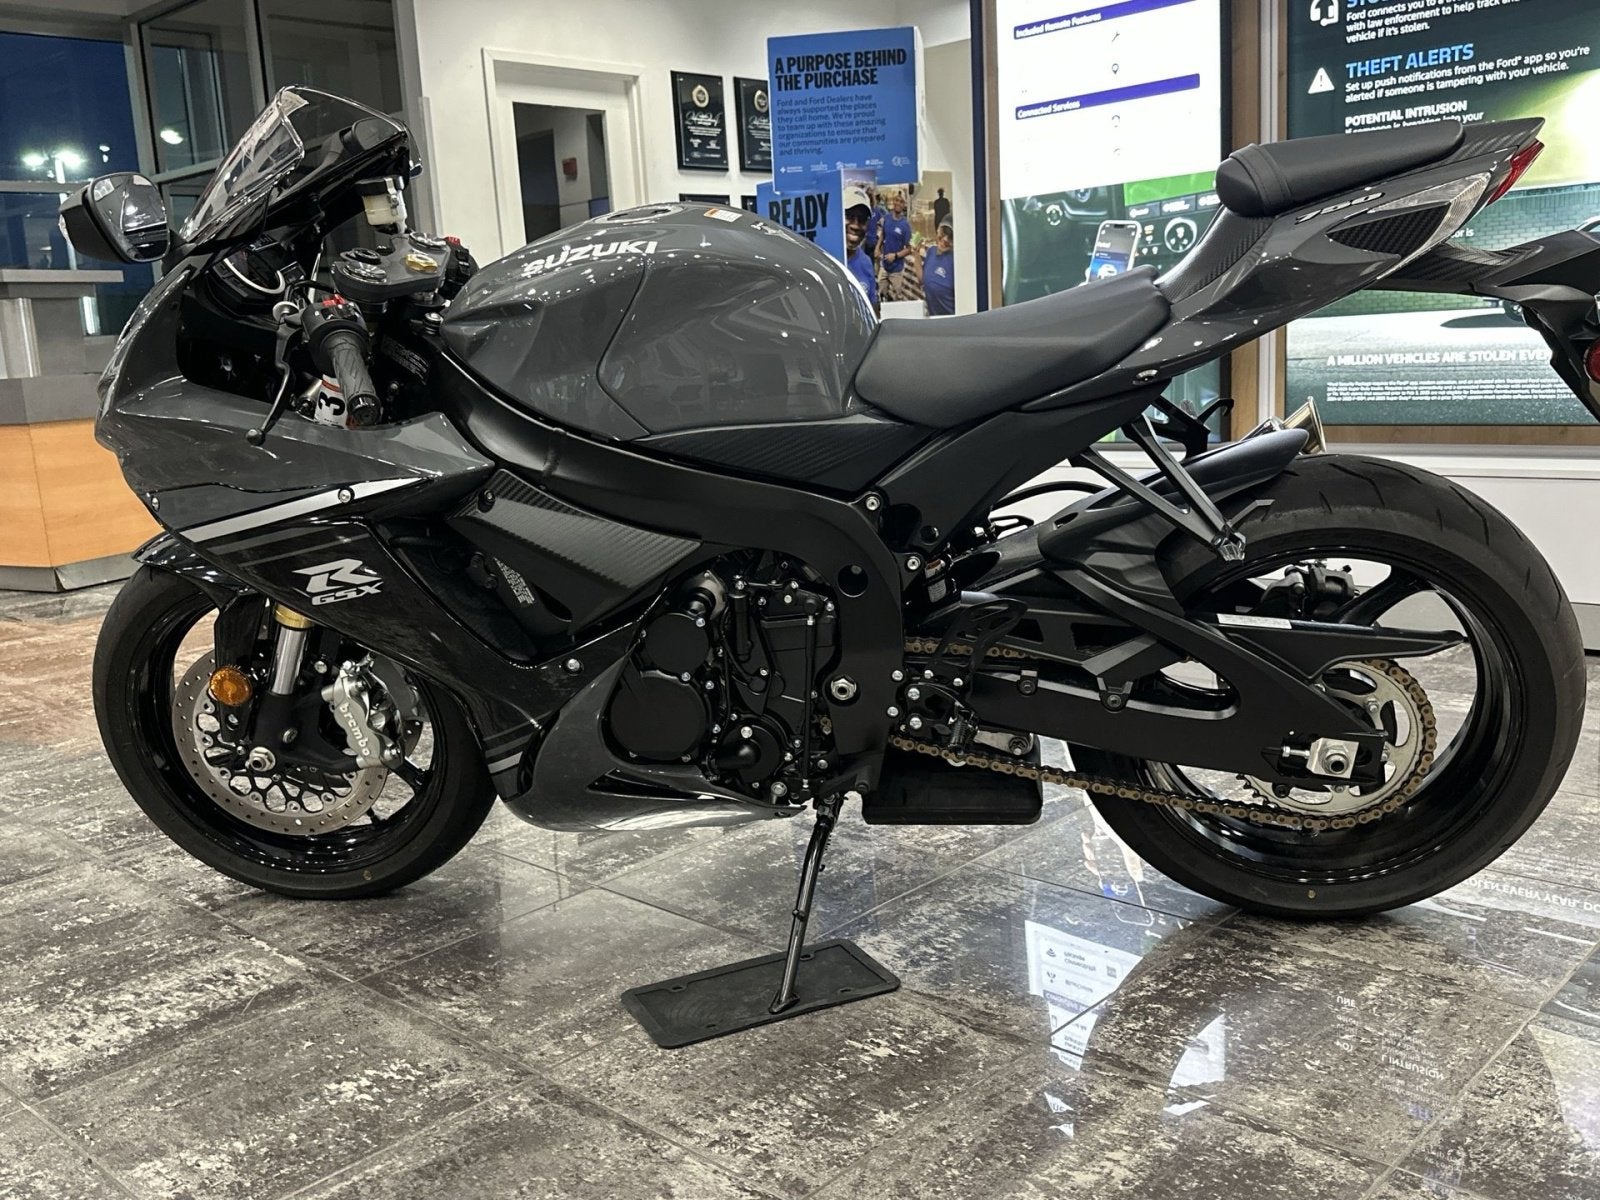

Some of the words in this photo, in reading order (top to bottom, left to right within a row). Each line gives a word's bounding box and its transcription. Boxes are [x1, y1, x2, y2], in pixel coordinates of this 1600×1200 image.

[1346, 10, 1366, 21] Ford
[1367, 4, 1406, 17] connects
[1407, 0, 1424, 11] you
[1346, 21, 1366, 32] with
[1366, 19, 1383, 28] law
[1384, 8, 1440, 25] enforcement
[1442, 7, 1452, 15] to
[1454, 2, 1475, 13] help
[1346, 30, 1376, 43] vehicle
[1400, 22, 1430, 34] stolen.
[775, 58, 784, 74] A
[786, 52, 852, 73] PURPOSE
[854, 48, 907, 69] BEHIND
[1346, 54, 1402, 78] THEFT
[1405, 43, 1474, 69] ALERTS
[1346, 82, 1360, 92] Set
[1361, 81, 1373, 90] up
[1375, 76, 1397, 88] push
[1398, 68, 1452, 83] notifications
[1454, 64, 1476, 75] from
[1478, 61, 1495, 72] the
[1524, 54, 1543, 65] app
[1545, 52, 1557, 61] so
[1559, 46, 1590, 60] you're
[775, 74, 802, 91] THE
[804, 68, 878, 89] PURCHASE
[1345, 90, 1375, 103] alerted
[1384, 83, 1425, 97] someone
[1426, 82, 1434, 91] is
[1436, 74, 1484, 89] tampering
[1485, 70, 1506, 82] with
[1508, 67, 1531, 80] your
[1532, 61, 1569, 75] vehicle.
[794, 98, 808, 106] and
[802, 105, 839, 114] supported
[854, 103, 877, 112] places
[1345, 110, 1404, 127] POTENTIAL
[1405, 100, 1468, 119] INTRUSION
[855, 119, 886, 128] amazing
[1462, 112, 1484, 124] your
[779, 131, 826, 140] organizations
[792, 139, 839, 147] communities
[853, 135, 886, 144] prepared
[768, 192, 829, 232] READY
[1466, 228, 1474, 236] is
[520, 241, 658, 277] SUZUKI
[1327, 355, 1335, 366] A
[1337, 354, 1383, 366] MILLION
[1384, 352, 1439, 365] VEHICLES
[1442, 351, 1466, 363] ARE
[1470, 350, 1516, 362] STOLEN
[1519, 350, 1552, 360] EVER
[292, 558, 382, 593] R
[312, 582, 384, 605] GSX
[340, 702, 370, 756] brembo
